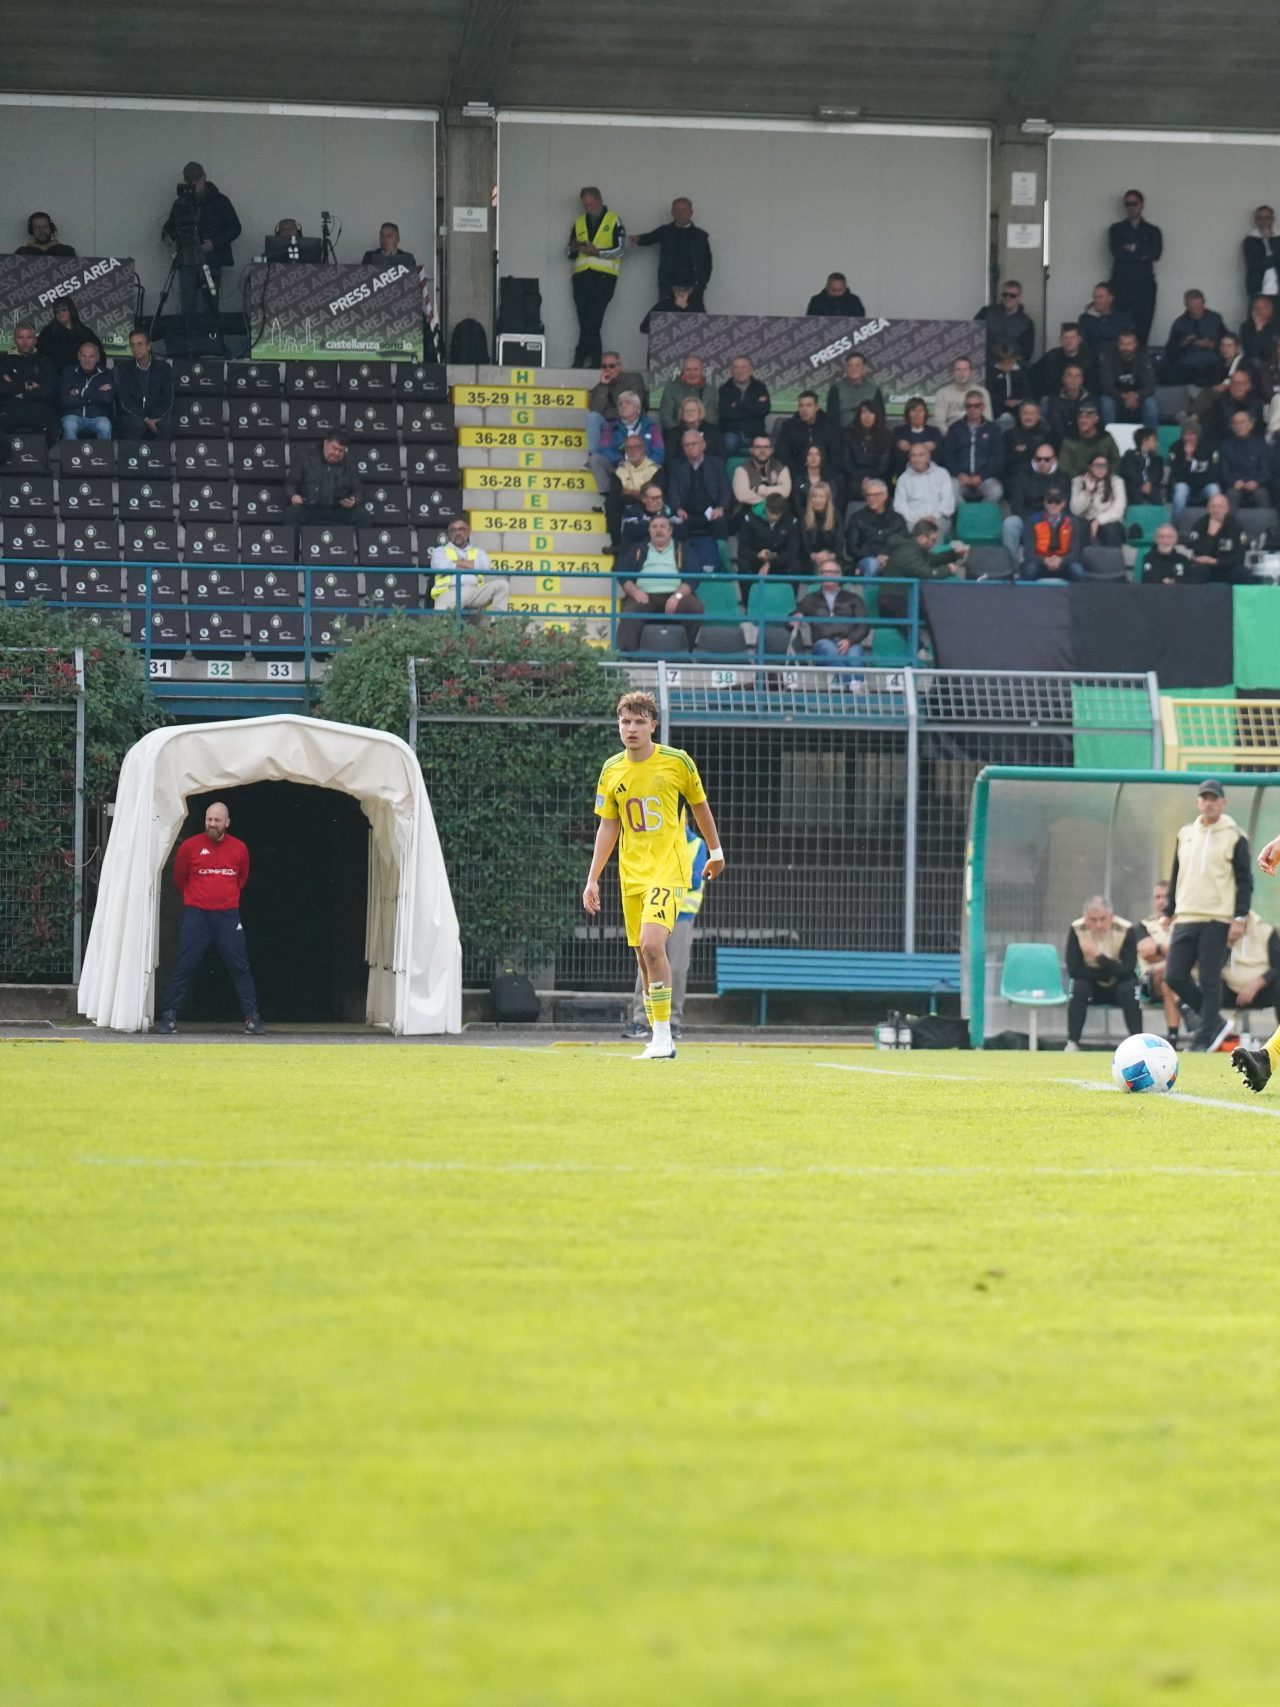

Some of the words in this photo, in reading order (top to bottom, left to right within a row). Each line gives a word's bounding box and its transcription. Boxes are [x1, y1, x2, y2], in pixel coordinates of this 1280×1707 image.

[38, 276, 82, 307] PRESS
[83, 257, 121, 284] AREA
[329, 284, 370, 315] PRESS
[372, 264, 409, 292] AREA
[810, 335, 852, 368] PRESS
[852, 317, 890, 346] AREA
[517, 371, 528, 384] H
[467, 392, 509, 404] 35-29
[515, 392, 527, 405] H
[533, 394, 574, 406] 38-62
[516, 411, 529, 424] G
[475, 432, 517, 445] 36-28
[522, 432, 534, 446] G
[541, 435, 582, 447] 37-63
[525, 453, 535, 465] F
[480, 475, 522, 487] 36-28
[528, 475, 537, 487] F
[543, 477, 585, 489] 37-63
[531, 495, 541, 507] E
[485, 517, 527, 529] 36-28
[533, 517, 544, 530] E
[550, 519, 592, 531] 37-63
[536, 537, 547, 549] D
[491, 560, 533, 571] 36-28
[540, 560, 551, 571] D
[557, 561, 599, 572] 37-63
[543, 579, 554, 591] C
[507, 603, 539, 612] 6-28
[150, 662, 167, 673] 31
[210, 663, 230, 675] 32
[270, 664, 290, 676] 33
[714, 672, 732, 684] 38
[651, 887, 671, 907] 27
